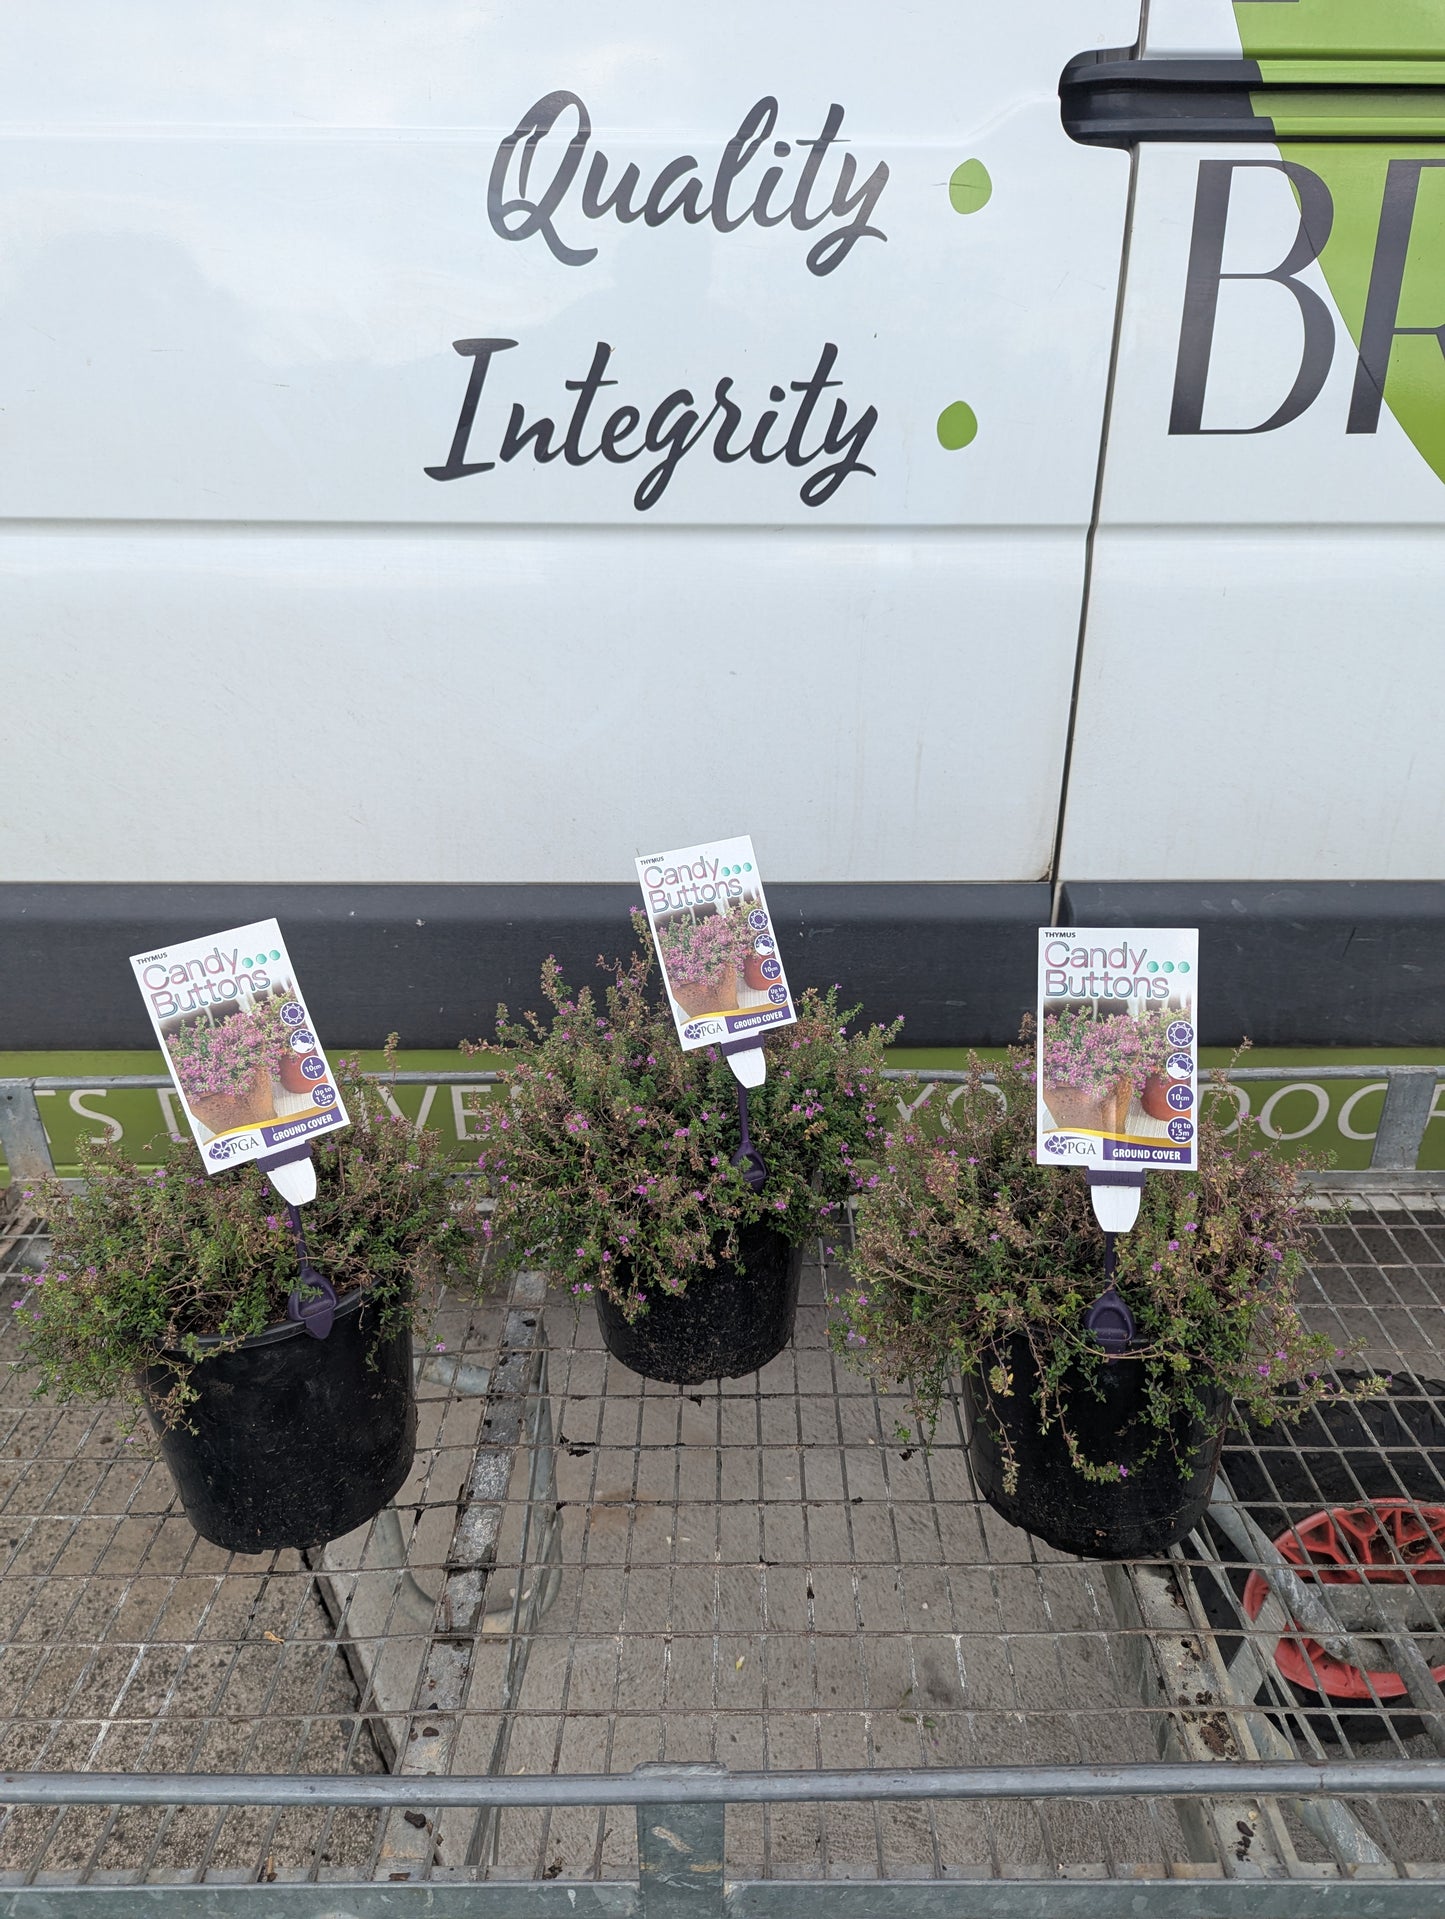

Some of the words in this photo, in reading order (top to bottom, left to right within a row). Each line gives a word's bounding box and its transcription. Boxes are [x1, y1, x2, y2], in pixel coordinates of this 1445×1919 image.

[486, 90, 890, 277] Quality
[424, 338, 879, 511] Integrity
[640, 856, 665, 866] THYMUS
[644, 856, 719, 888] Candy
[648, 878, 743, 914] Buttons
[136, 952, 168, 965] THYMUS
[1044, 941, 1148, 975] Candy
[143, 947, 237, 990] Candy
[1045, 969, 1170, 998] Buttons
[151, 969, 271, 1019] Buttons
[700, 1022, 724, 1037] PGA
[733, 1016, 761, 1030] GROUND
[762, 1010, 784, 1023] COVER
[305, 1064, 322, 1073] 10cm
[315, 1089, 325, 1097] Up
[1171, 1093, 1190, 1101] 10cm
[272, 1123, 307, 1142] GROUND
[307, 1113, 334, 1130] COVER
[1171, 1129, 1190, 1137] 1.5m
[1172, 1121, 1182, 1130] Up
[229, 1136, 260, 1155] PGA
[1067, 1140, 1097, 1155] PGA
[1112, 1148, 1150, 1160] GROUND
[1151, 1150, 1181, 1161] COVER
